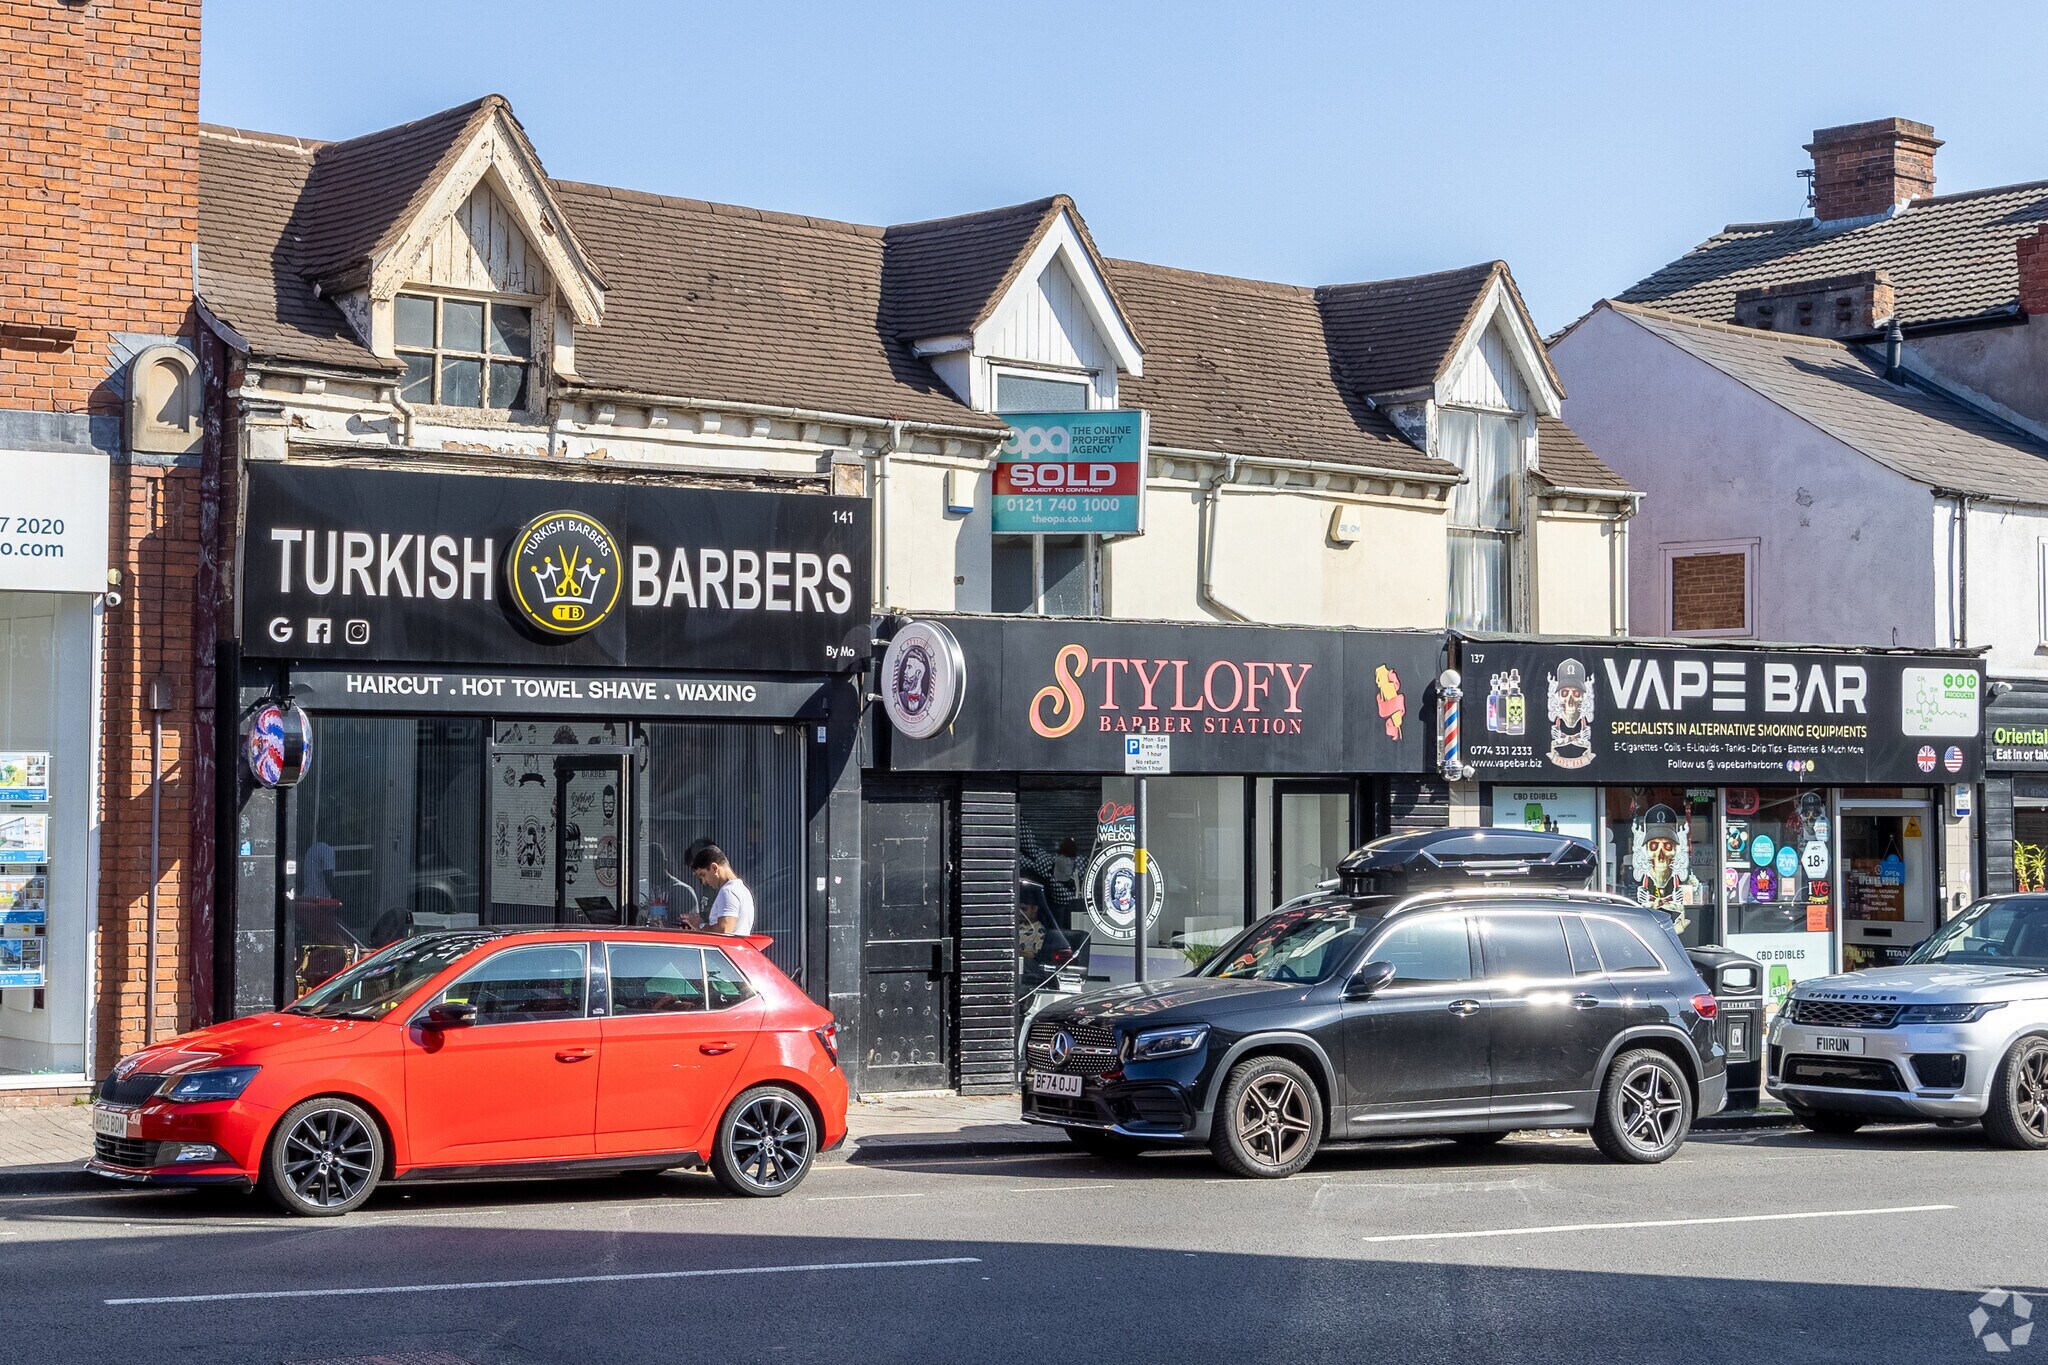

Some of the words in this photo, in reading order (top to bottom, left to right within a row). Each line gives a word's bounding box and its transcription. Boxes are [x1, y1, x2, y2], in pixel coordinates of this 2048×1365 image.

[1072, 426, 1091, 435] THE
[1094, 425, 1131, 435] ONLINE
[1072, 435, 1123, 444] PROPERTY
[1071, 445, 1113, 454] AGENCY
[1010, 464, 1117, 486] SOLD
[1007, 498, 1042, 512] 0121
[1048, 498, 1077, 512] 740
[1082, 498, 1120, 512] 1000
[832, 511, 854, 525] 141
[1032, 514, 1093, 525] theopa.co.uk
[16, 517, 65, 535] 2020
[523, 520, 565, 556] TURKISH
[568, 520, 612, 557] BARBERS
[271, 528, 494, 601] TURKISH
[632, 545, 852, 615] BARBERS
[826, 645, 839, 660] By
[840, 646, 855, 657] Mo
[1470, 653, 1485, 664] 137
[346, 674, 443, 696] HAIRCUT
[462, 678, 505, 697] HOT
[511, 679, 583, 700] TOWEL
[588, 681, 657, 701] SHAVE
[676, 683, 757, 702] WAXING
[1603, 658, 1746, 712] VAPE
[1764, 661, 1867, 714] BAR
[1945, 676, 1975, 686] CBD
[1029, 643, 1313, 738] STYLOFY
[1099, 715, 1193, 733] BARBER
[1204, 717, 1303, 735] STATION
[1611, 721, 1674, 736] SPECIALISTS
[1676, 722, 1687, 735] IN
[1689, 722, 1756, 737] ALTERNATIVE
[1757, 724, 1804, 737] SMOKING
[1806, 725, 1867, 739] EQUIPMENTS
[1995, 727, 2048, 745] Oriental
[1130, 740, 1139, 754] P
[1470, 745, 1493, 755] 0774
[1495, 746, 1509, 755] 331
[1511, 746, 1532, 756] 2333
[1614, 742, 1659, 753] E-Cigarettes
[1663, 742, 1681, 752] Coils
[1686, 743, 1720, 754] E-Liquids
[1725, 743, 1746, 752] Tanks
[1751, 743, 1767, 754] Drip
[1768, 744, 1783, 754] Tips
[1787, 744, 1818, 753] Batteries
[1827, 745, 1846, 753] Much
[1996, 748, 2012, 760] Eat
[2013, 748, 2022, 759] in
[2024, 751, 2033, 760] or
[1471, 758, 1542, 769] www.vapebar.biz
[1667, 759, 1695, 769] Follow
[1696, 761, 1705, 769] us
[1706, 760, 1715, 770] @
[1716, 760, 1783, 770] vapebarharborne
[1513, 792, 1528, 800] CBD
[1530, 792, 1558, 800] EDIBLES
[1099, 801, 1135, 824] Ope
[1807, 855, 1825, 868] 18+
[1757, 951, 1772, 960] CBD
[1775, 950, 1805, 960] EDIBLES
[1771, 986, 1787, 996] CBD
[1808, 992, 1846, 1000] RANGE
[1036, 1074, 1057, 1090] BF74
